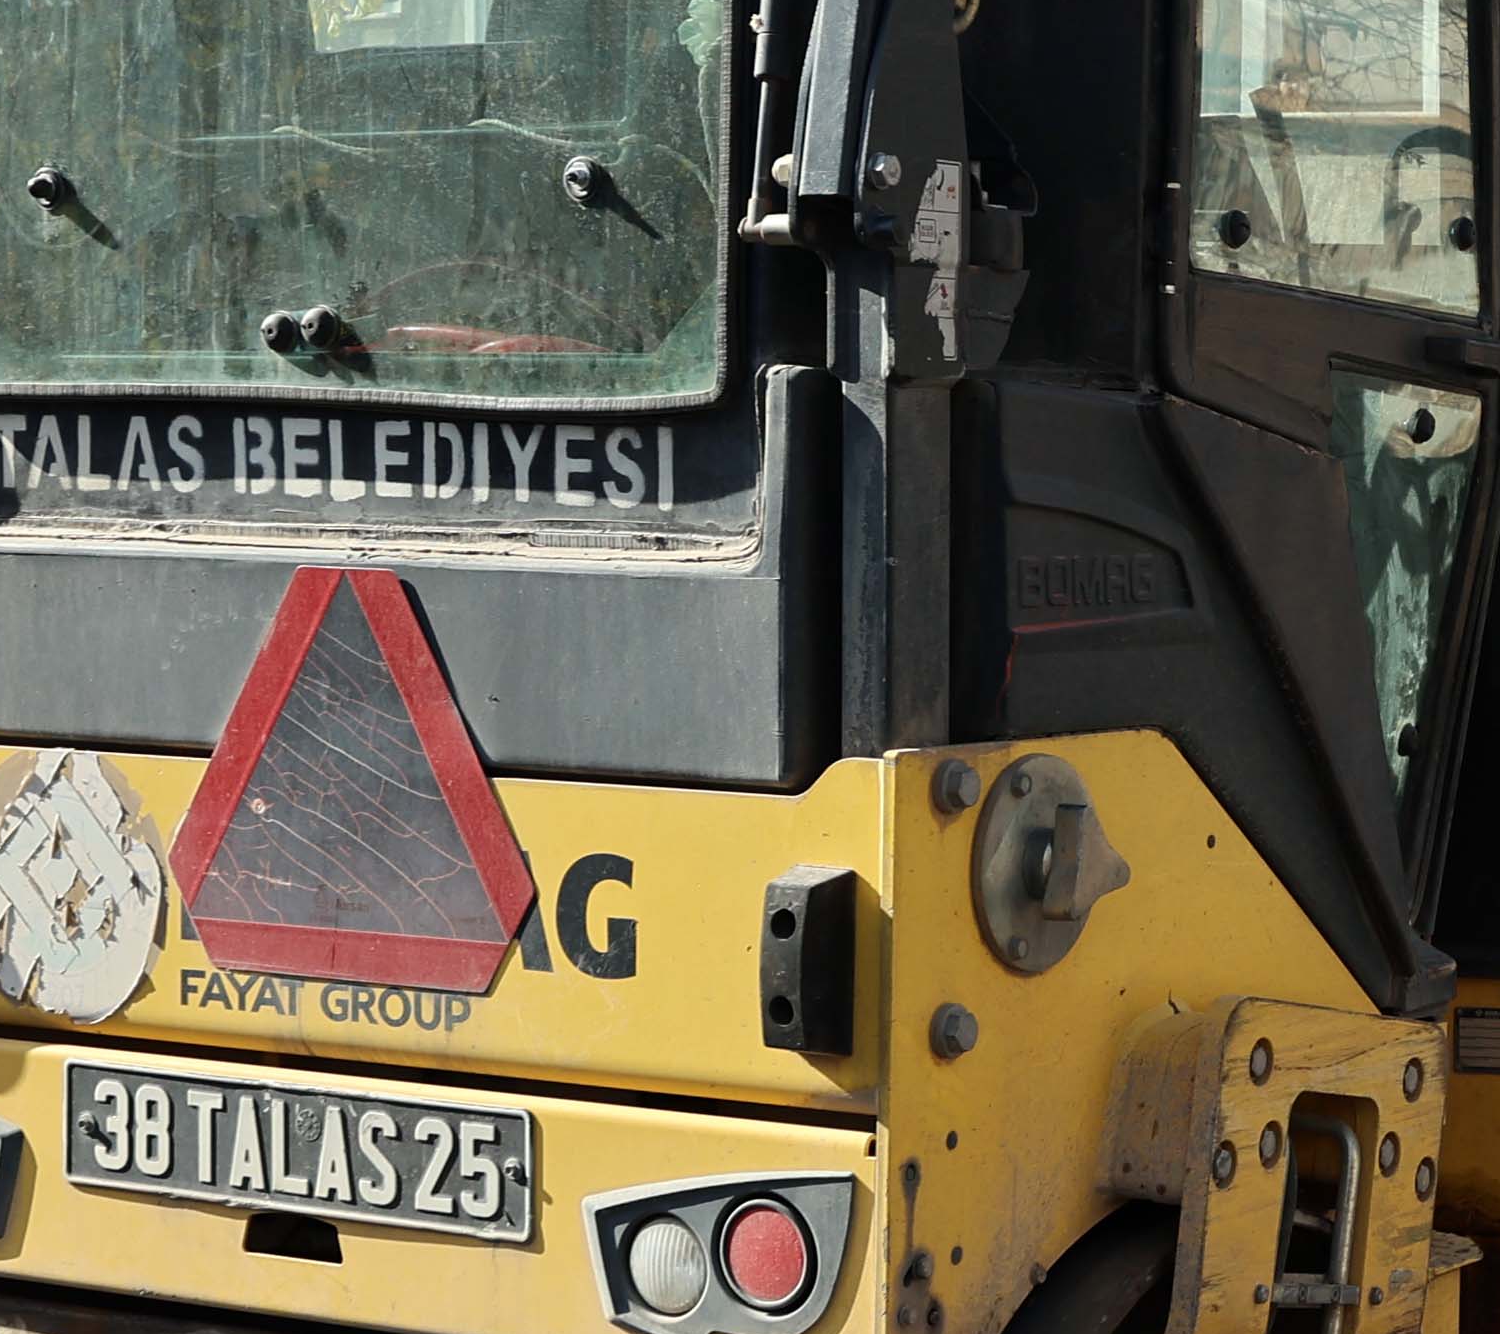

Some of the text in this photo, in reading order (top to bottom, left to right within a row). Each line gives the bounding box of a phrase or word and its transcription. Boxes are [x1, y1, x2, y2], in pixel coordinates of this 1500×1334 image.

[232, 417, 675, 513] BELEDIYESI
[1016, 553, 1156, 610] BOMAG
[179, 969, 472, 1032] FAYAT GROUP
[93, 1079, 500, 1219] 38 TALAS 25
